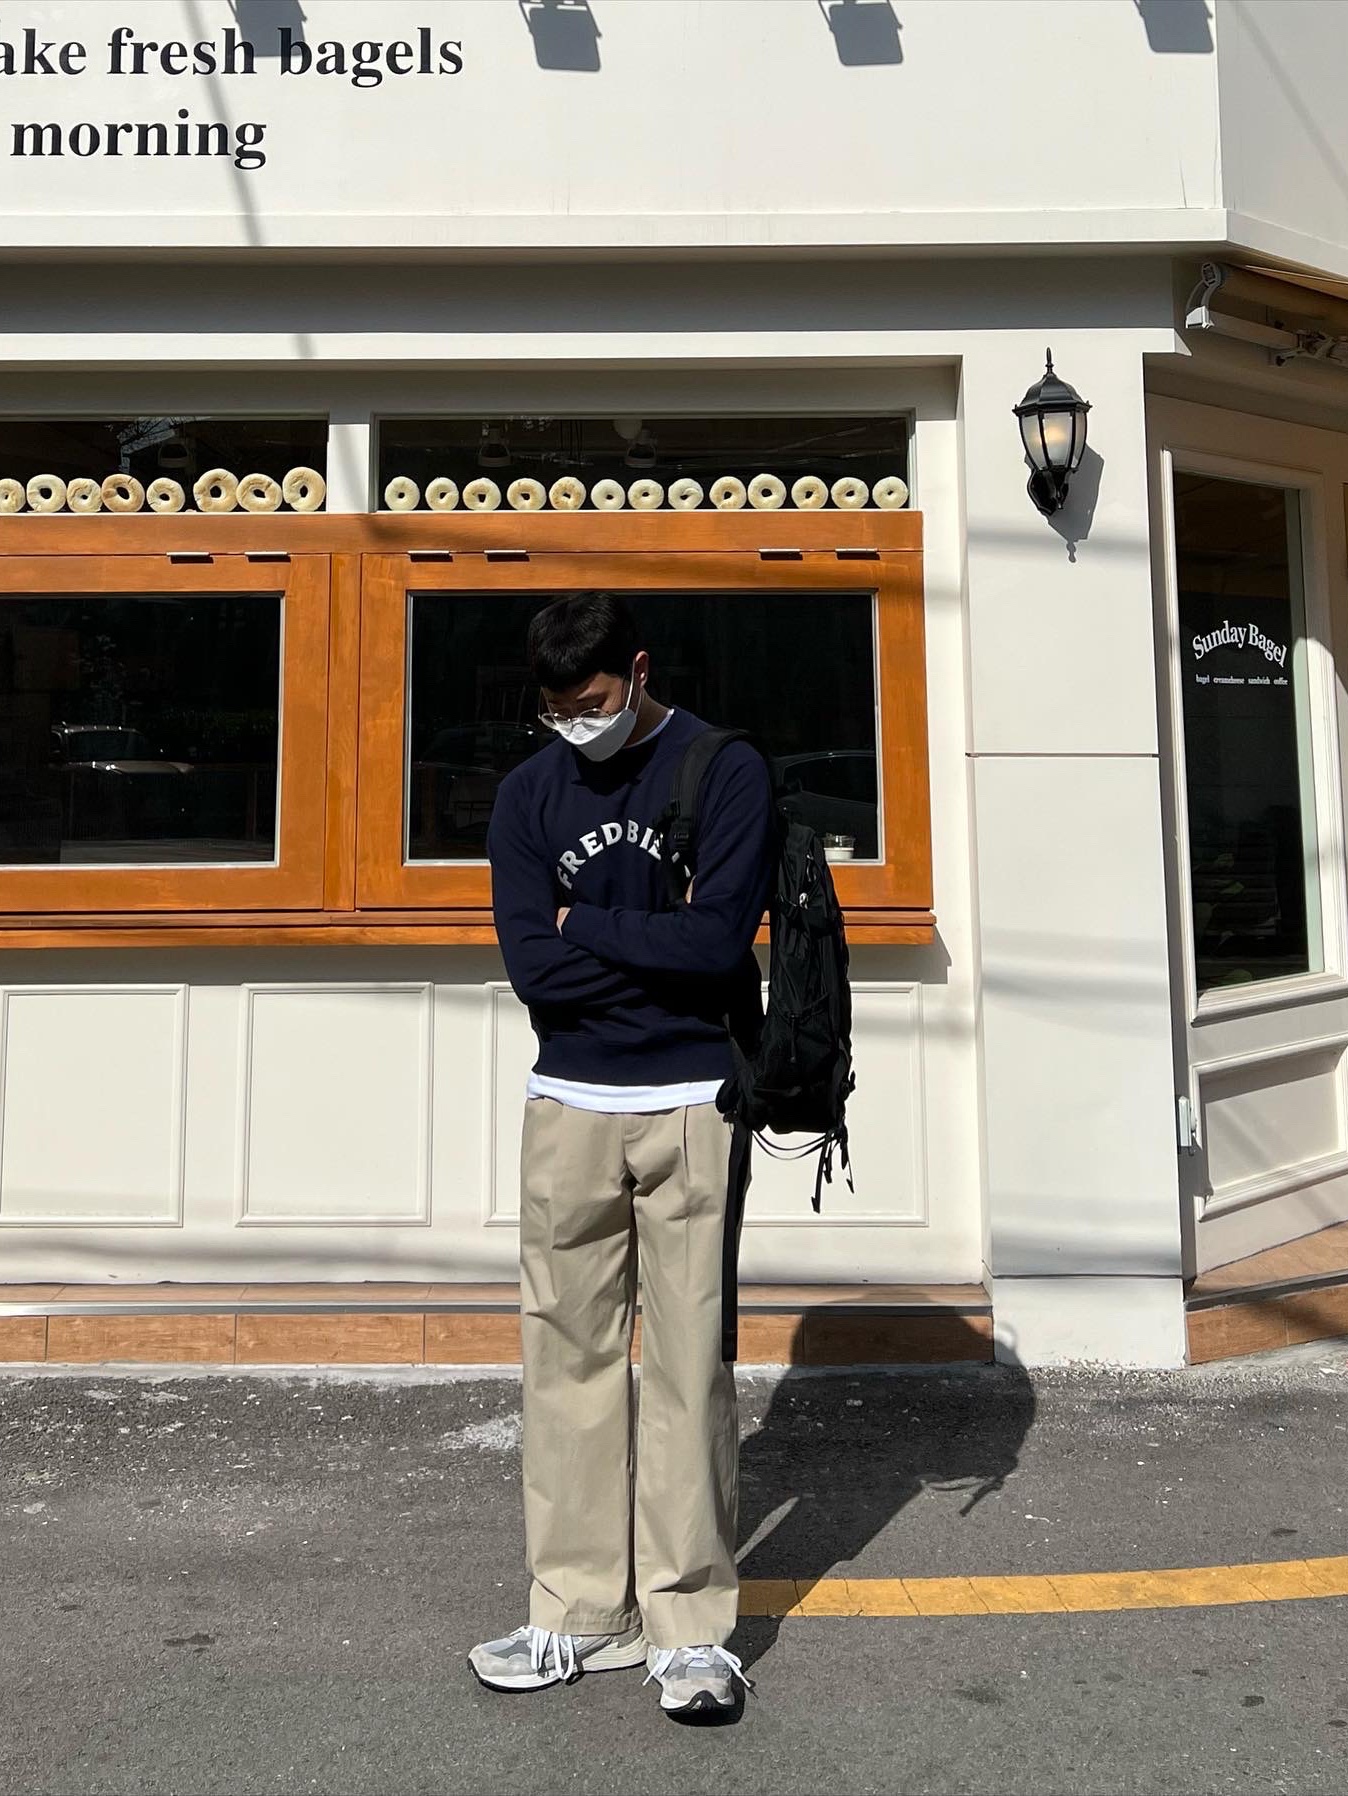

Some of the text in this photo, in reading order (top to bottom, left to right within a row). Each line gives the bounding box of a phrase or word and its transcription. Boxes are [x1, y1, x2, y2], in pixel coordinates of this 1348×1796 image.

[106, 27, 257, 76] fresh
[278, 27, 464, 88] bagels
[10, 108, 268, 170] morning
[1192, 620, 1288, 668] Sunday Bagel
